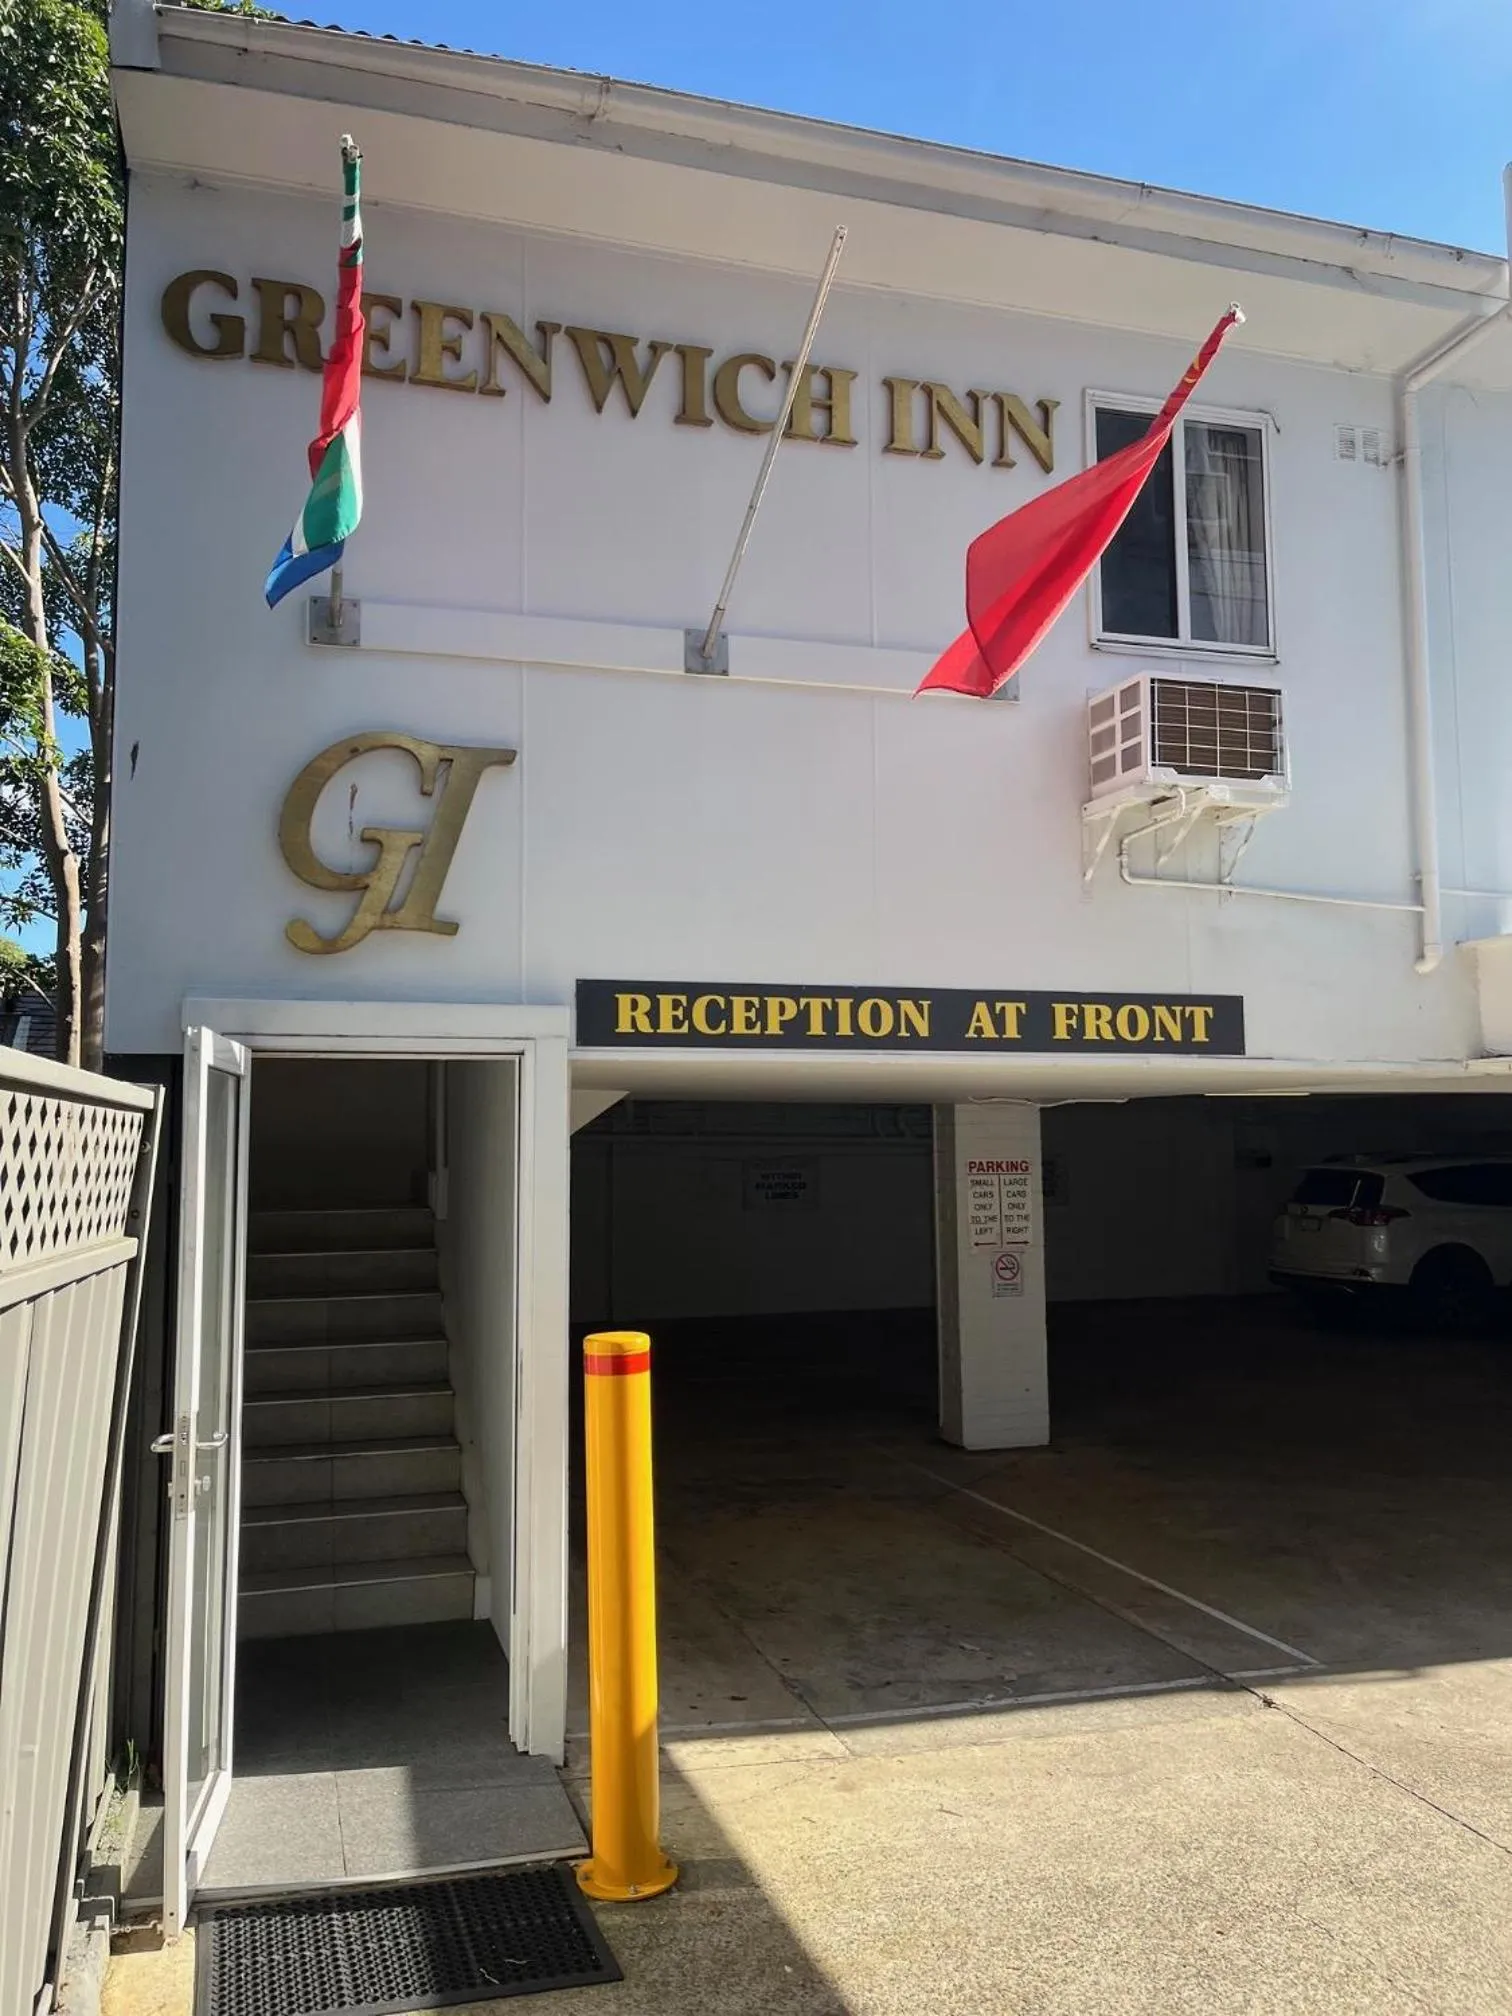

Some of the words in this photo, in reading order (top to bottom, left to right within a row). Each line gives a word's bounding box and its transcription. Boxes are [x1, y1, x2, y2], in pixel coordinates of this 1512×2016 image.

[161, 269, 859, 448] GREENWICH
[883, 376, 1060, 475] INN
[614, 993, 932, 1038] RECEPTION
[965, 1001, 1027, 1040] AT
[1050, 1002, 1215, 1043] FRONT
[968, 1161, 1030, 1173] PARKING
[970, 1178, 995, 1187] SMALL
[1003, 1178, 1029, 1186] LARGE
[973, 1191, 995, 1199] CARS
[1006, 1190, 1027, 1198] CARS
[974, 1203, 994, 1212] ONLY
[1007, 1202, 1026, 1210] ONLY
[971, 1215, 982, 1224] TO
[984, 1215, 998, 1224] THE
[1004, 1214, 1014, 1222] TO
[1016, 1214, 1030, 1222] THE
[975, 1227, 994, 1236] LEFT
[1006, 1226, 1029, 1235] RIGHT
